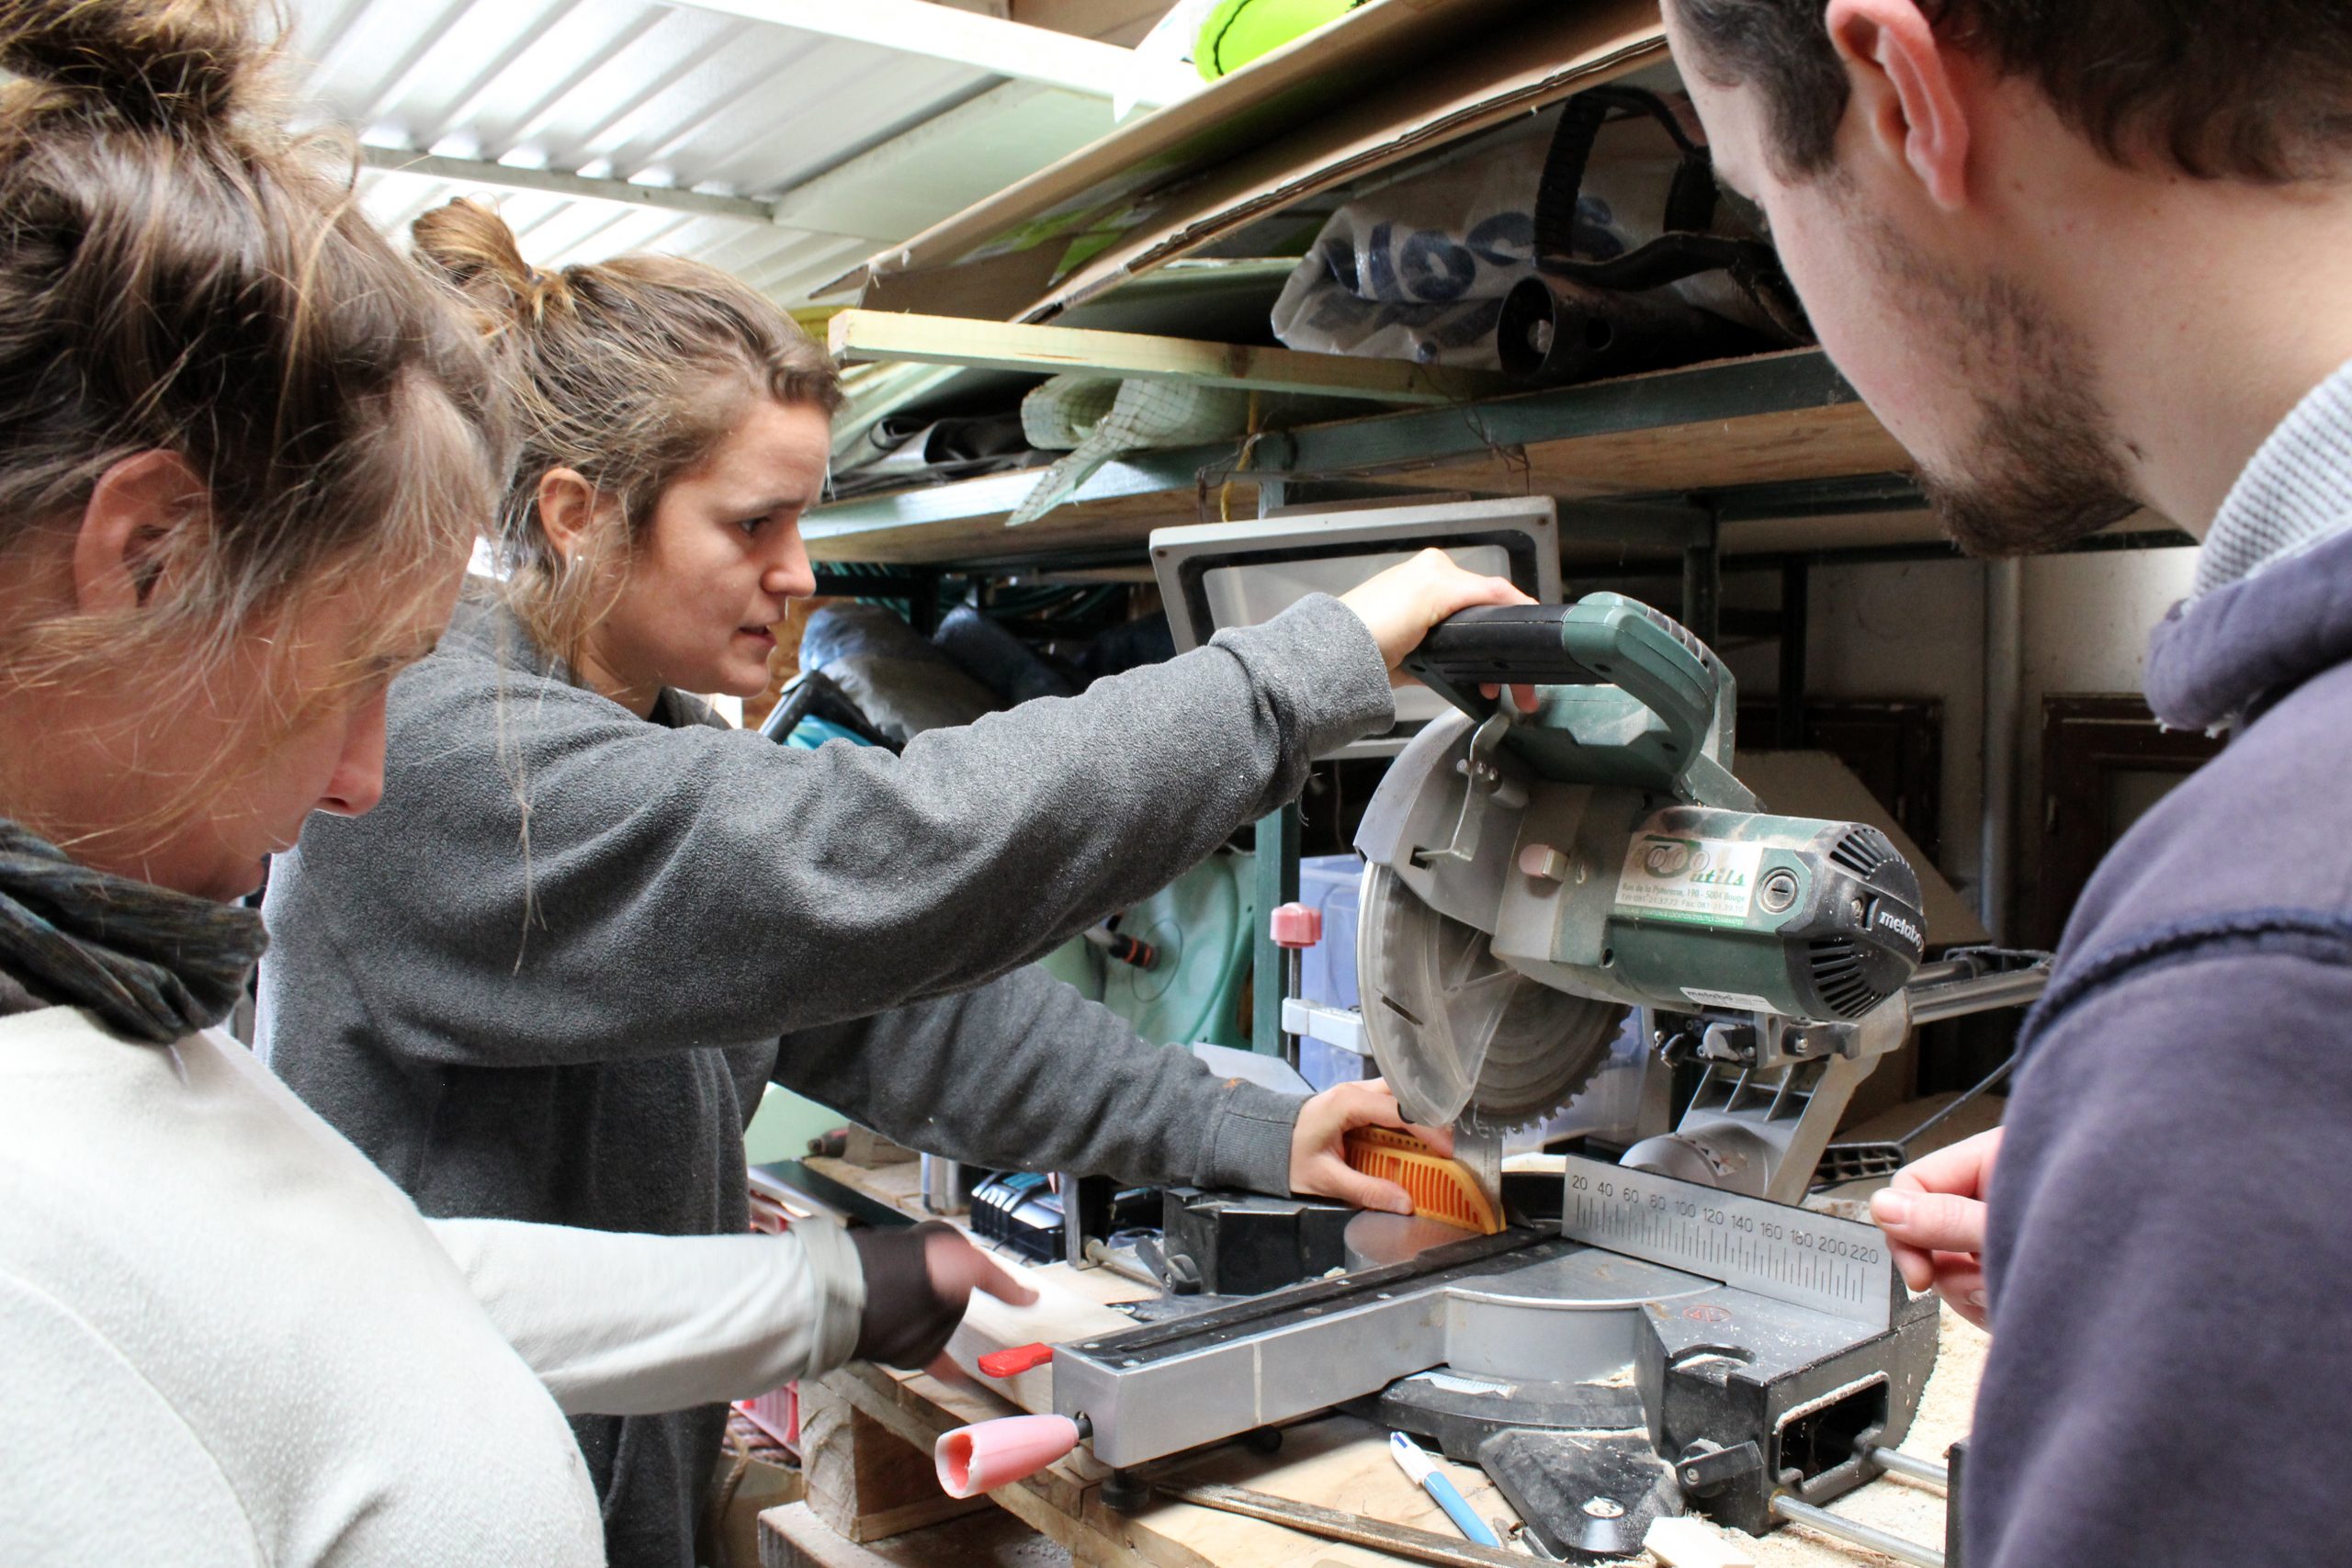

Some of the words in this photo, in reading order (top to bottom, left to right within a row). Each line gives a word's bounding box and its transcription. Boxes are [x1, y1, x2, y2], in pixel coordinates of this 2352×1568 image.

[1879, 911, 1922, 947] metabo
[1573, 1175, 1588, 1190] 20
[1598, 1183, 1613, 1197] 40
[1623, 1188, 1638, 1203] 60
[1650, 1195, 1666, 1211] 80
[1676, 1201, 1695, 1218] 100
[1703, 1208, 1724, 1224] 120
[1732, 1215, 1753, 1233] 140
[1761, 1222, 1782, 1240] 160
[1792, 1229, 1813, 1247] 180
[1818, 1236, 1847, 1257] 200
[1850, 1245, 1878, 1264] 220
